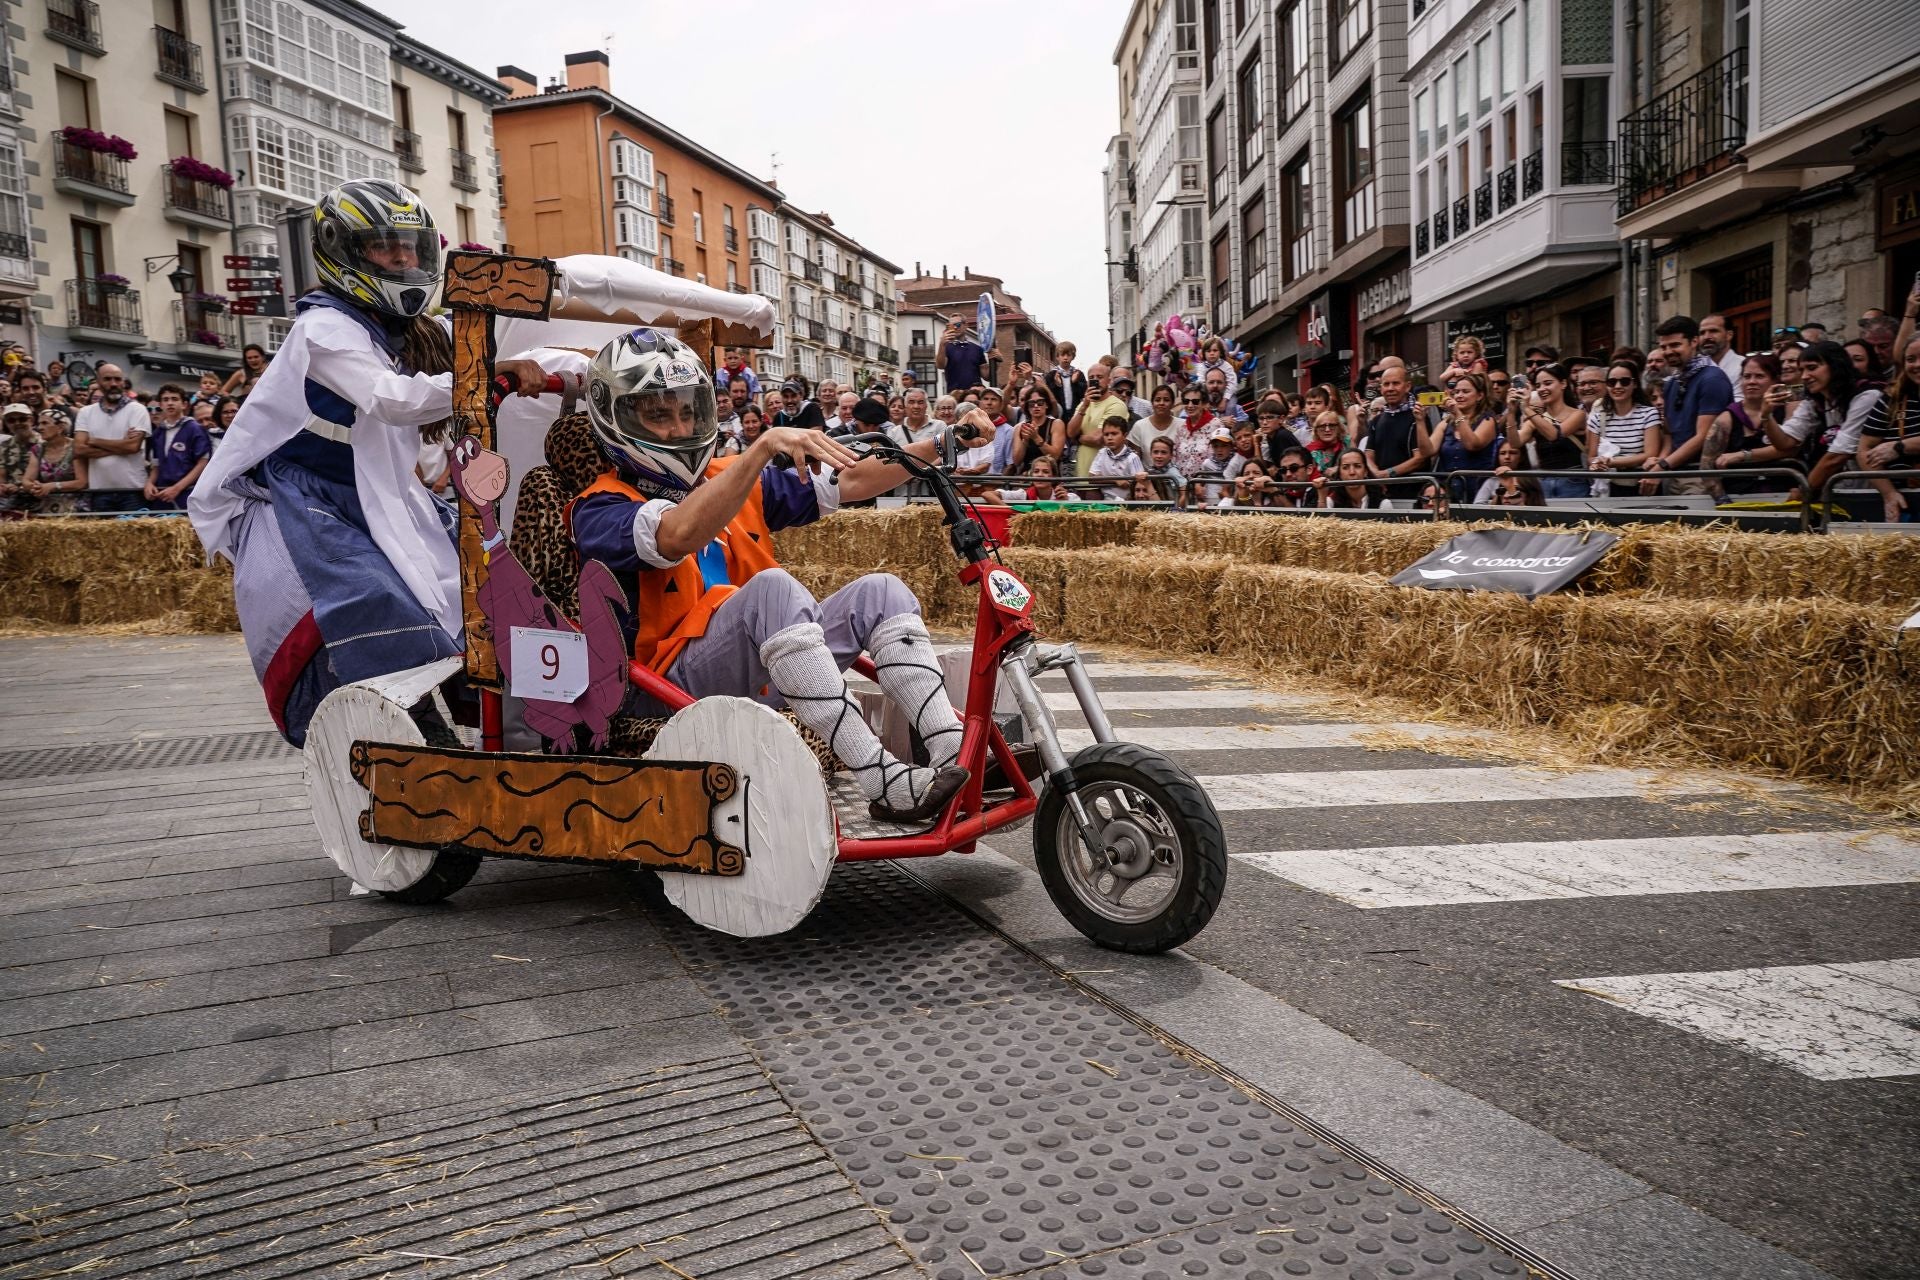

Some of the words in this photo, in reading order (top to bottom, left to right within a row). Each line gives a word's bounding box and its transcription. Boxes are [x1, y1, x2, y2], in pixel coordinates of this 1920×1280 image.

[391, 215, 421, 223] VEMAR
[1439, 550, 1469, 565] la
[1472, 556, 1577, 568] comarca
[541, 644, 560, 681] 9
